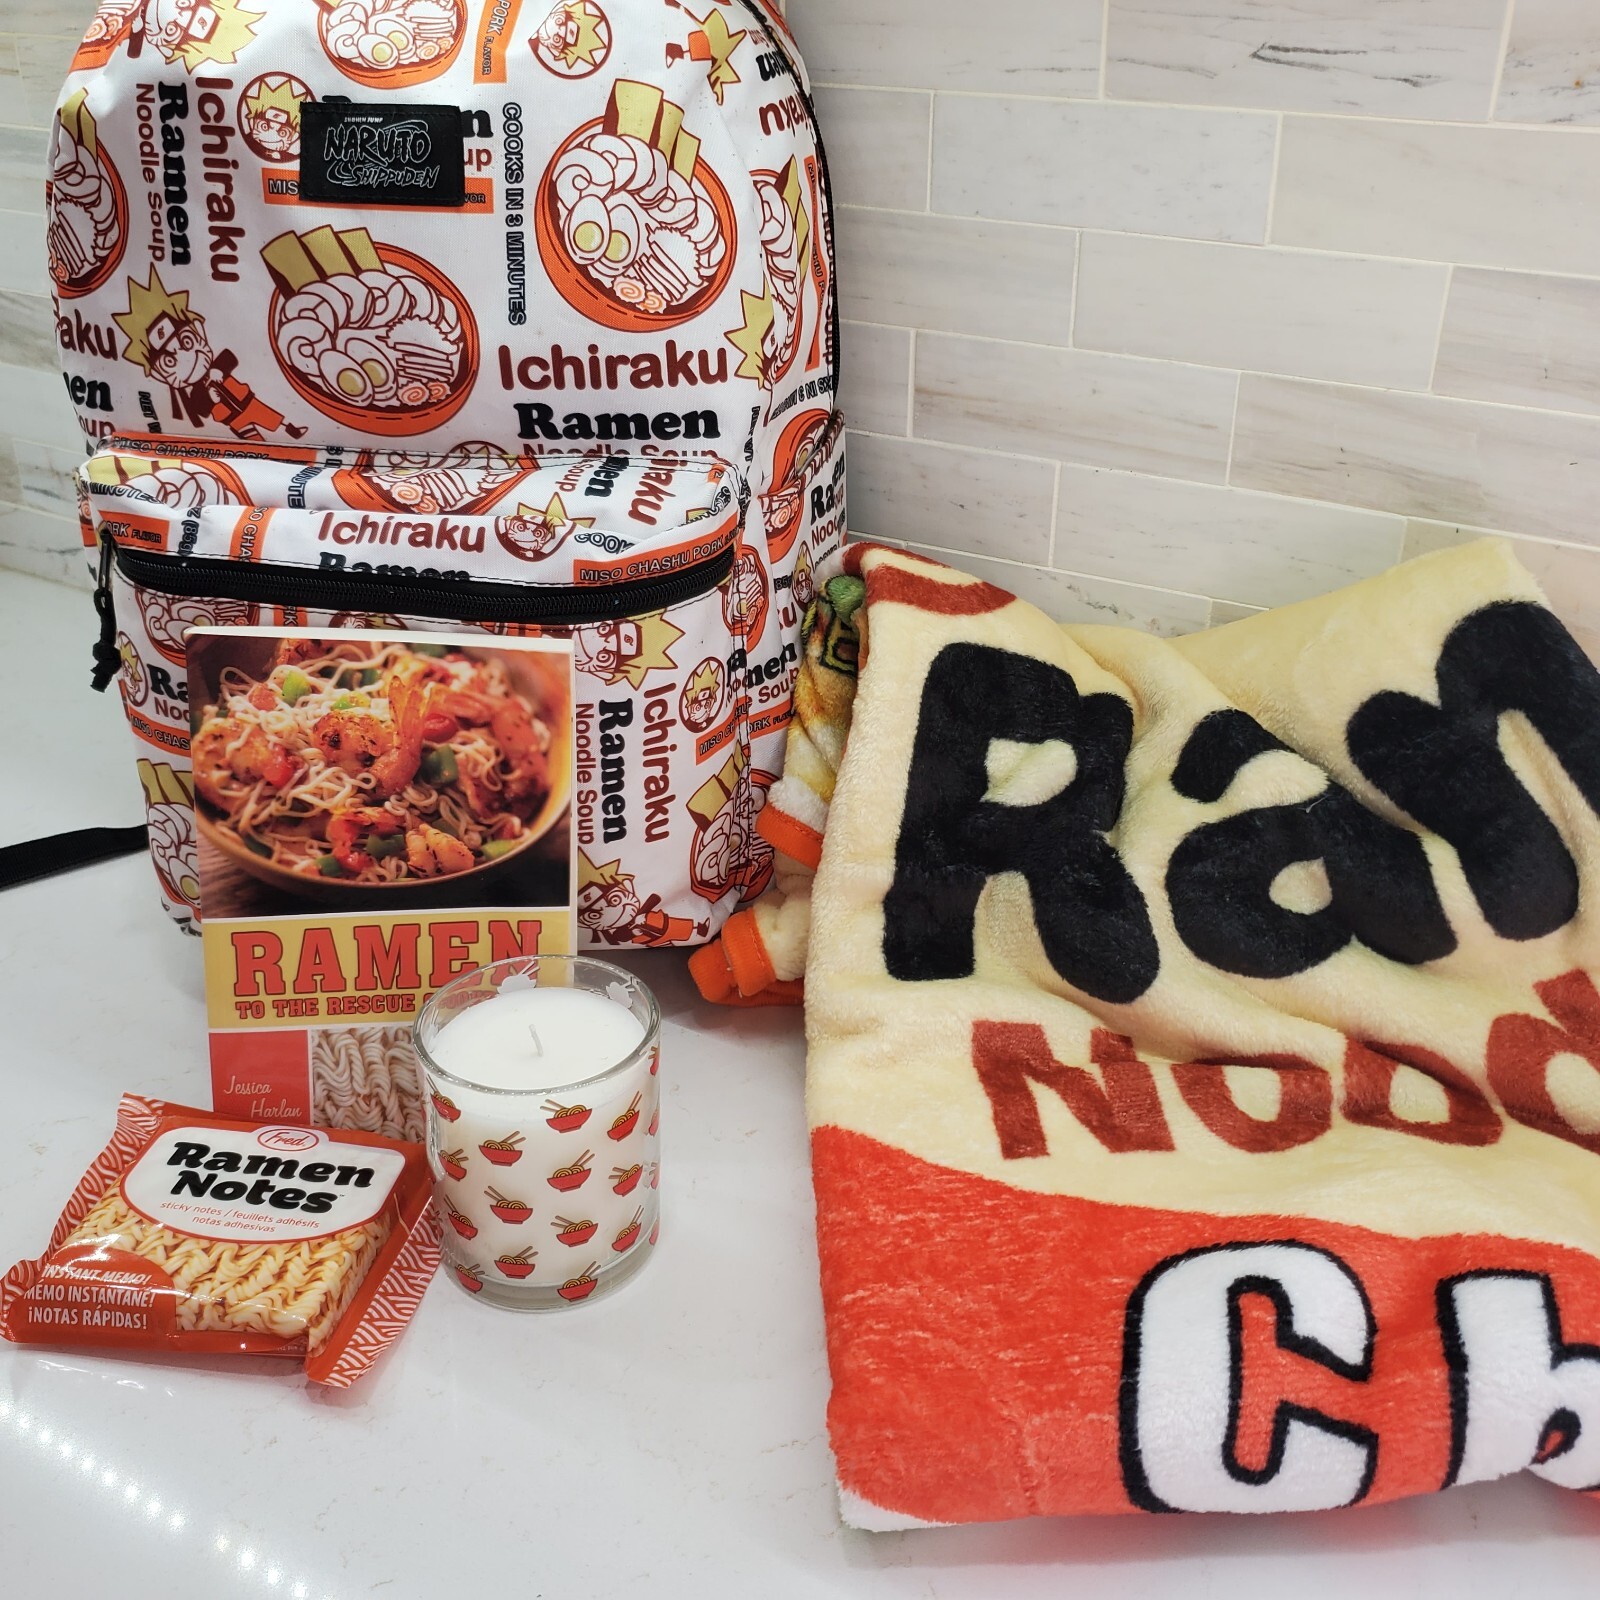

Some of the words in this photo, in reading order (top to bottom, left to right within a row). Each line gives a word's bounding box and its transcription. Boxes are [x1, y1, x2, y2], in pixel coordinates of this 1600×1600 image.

[481, 36, 495, 76] FLAVOR
[136, 83, 160, 184] Noodle
[324, 122, 432, 167] NARUTO
[502, 102, 525, 184] COOKS
[158, 81, 191, 266] Ramen
[195, 76, 245, 282] Ichiraku
[268, 178, 299, 195] MIS
[344, 165, 441, 189] SHIPPUDEN
[505, 187, 524, 211] IN
[505, 213, 524, 228] 3
[147, 191, 166, 262] Soup
[506, 231, 526, 326] MINUTES
[498, 339, 728, 391] Ichiraku
[513, 402, 721, 441] Ramen
[318, 512, 486, 553] Ichiraku
[580, 568, 622, 582] MISO
[627, 552, 691, 577] CHASHU
[693, 536, 724, 561] PORK
[575, 702, 597, 785] Noodle
[643, 682, 678, 843] Ichiraku
[598, 698, 634, 844] Ramen
[576, 788, 598, 846] Soup
[231, 919, 543, 997] RAMEN
[235, 1000, 266, 1020] TO
[272, 997, 320, 1018] THE
[327, 993, 416, 1016] RESCUE
[223, 1075, 273, 1095] Jessica
[250, 1097, 302, 1118] Harlan
[166, 1141, 375, 1188] Ramen
[160, 1202, 191, 1215] sticky
[193, 1206, 223, 1217] notes
[232, 1210, 274, 1223] feuillets
[170, 1170, 339, 1214] Notes
[191, 1215, 222, 1227] notas
[225, 1219, 276, 1233] adhesivas
[28, 1305, 78, 1326] ¡NOTAS
[82, 1304, 148, 1330] RÁPIDAS!
